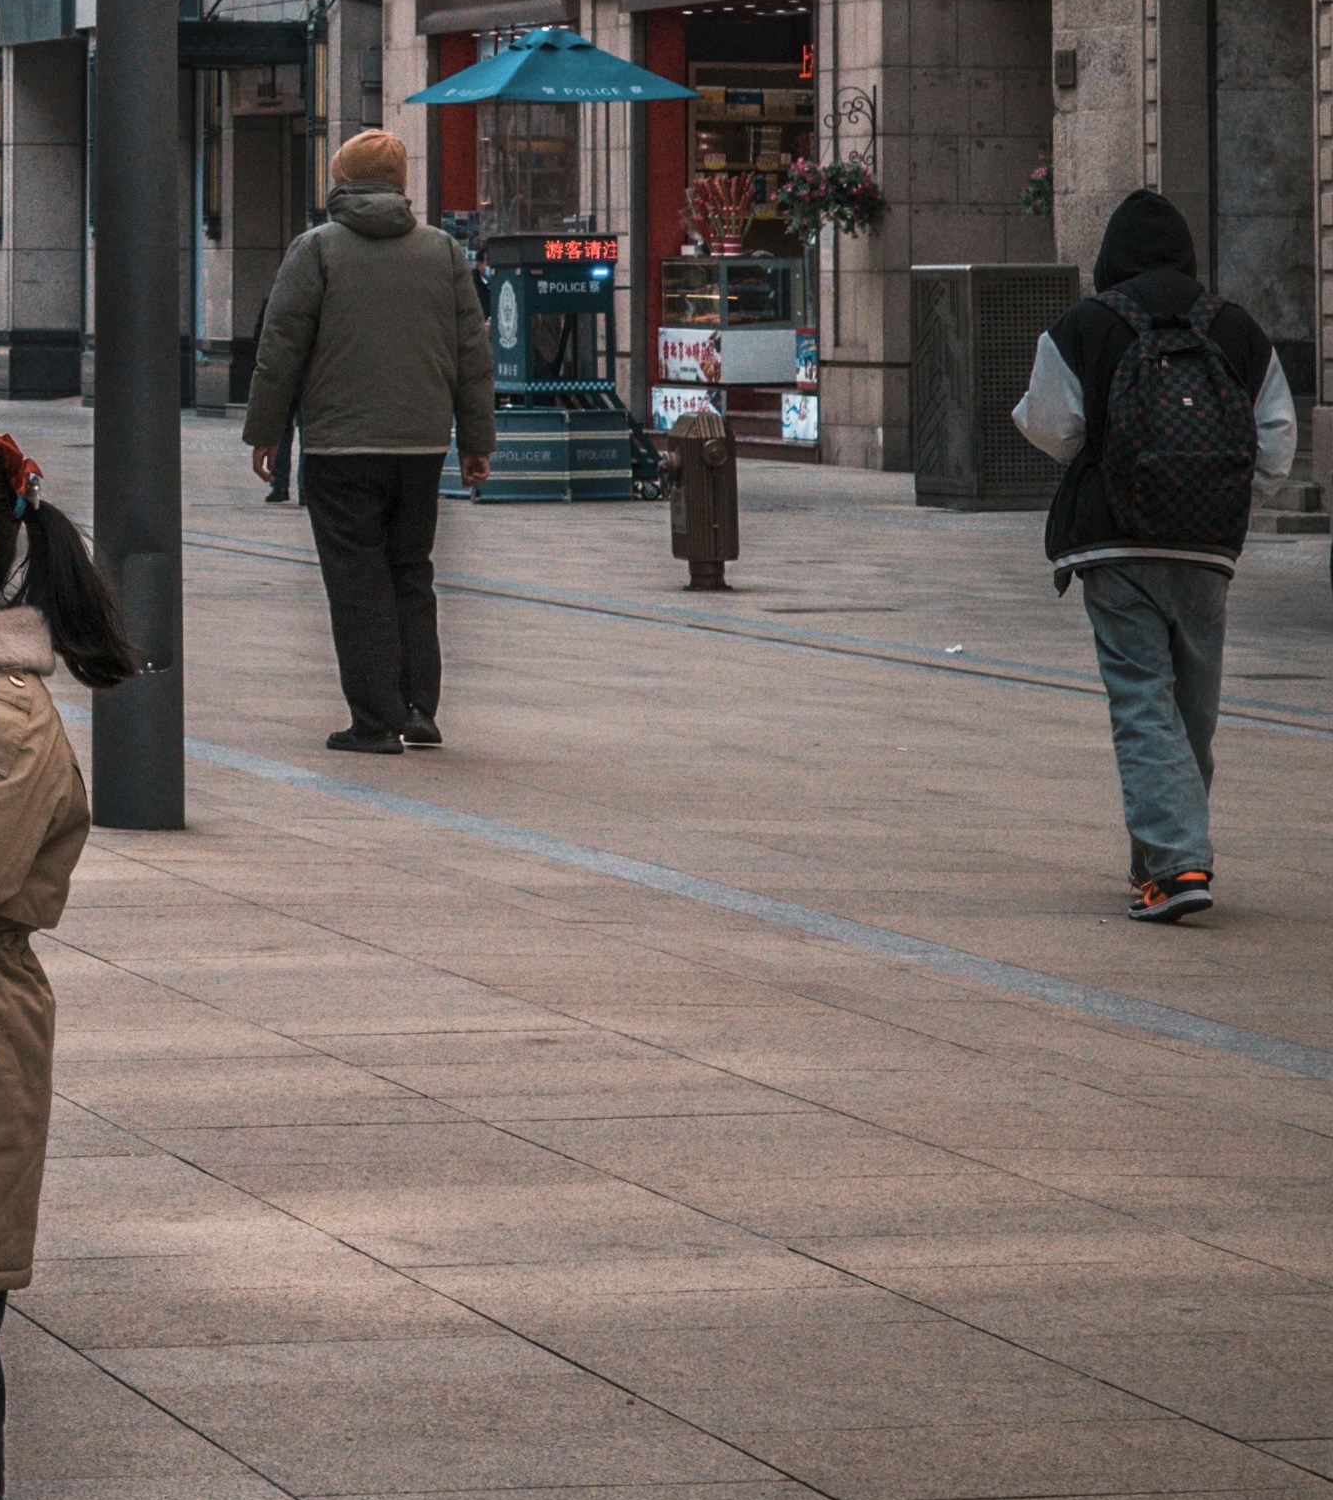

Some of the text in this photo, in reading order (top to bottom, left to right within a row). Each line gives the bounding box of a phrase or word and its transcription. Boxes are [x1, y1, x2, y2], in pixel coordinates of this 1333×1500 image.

[563, 86, 621, 97] POLICE
[544, 239, 618, 260] 游客请注
[549, 282, 587, 293] POLICE
